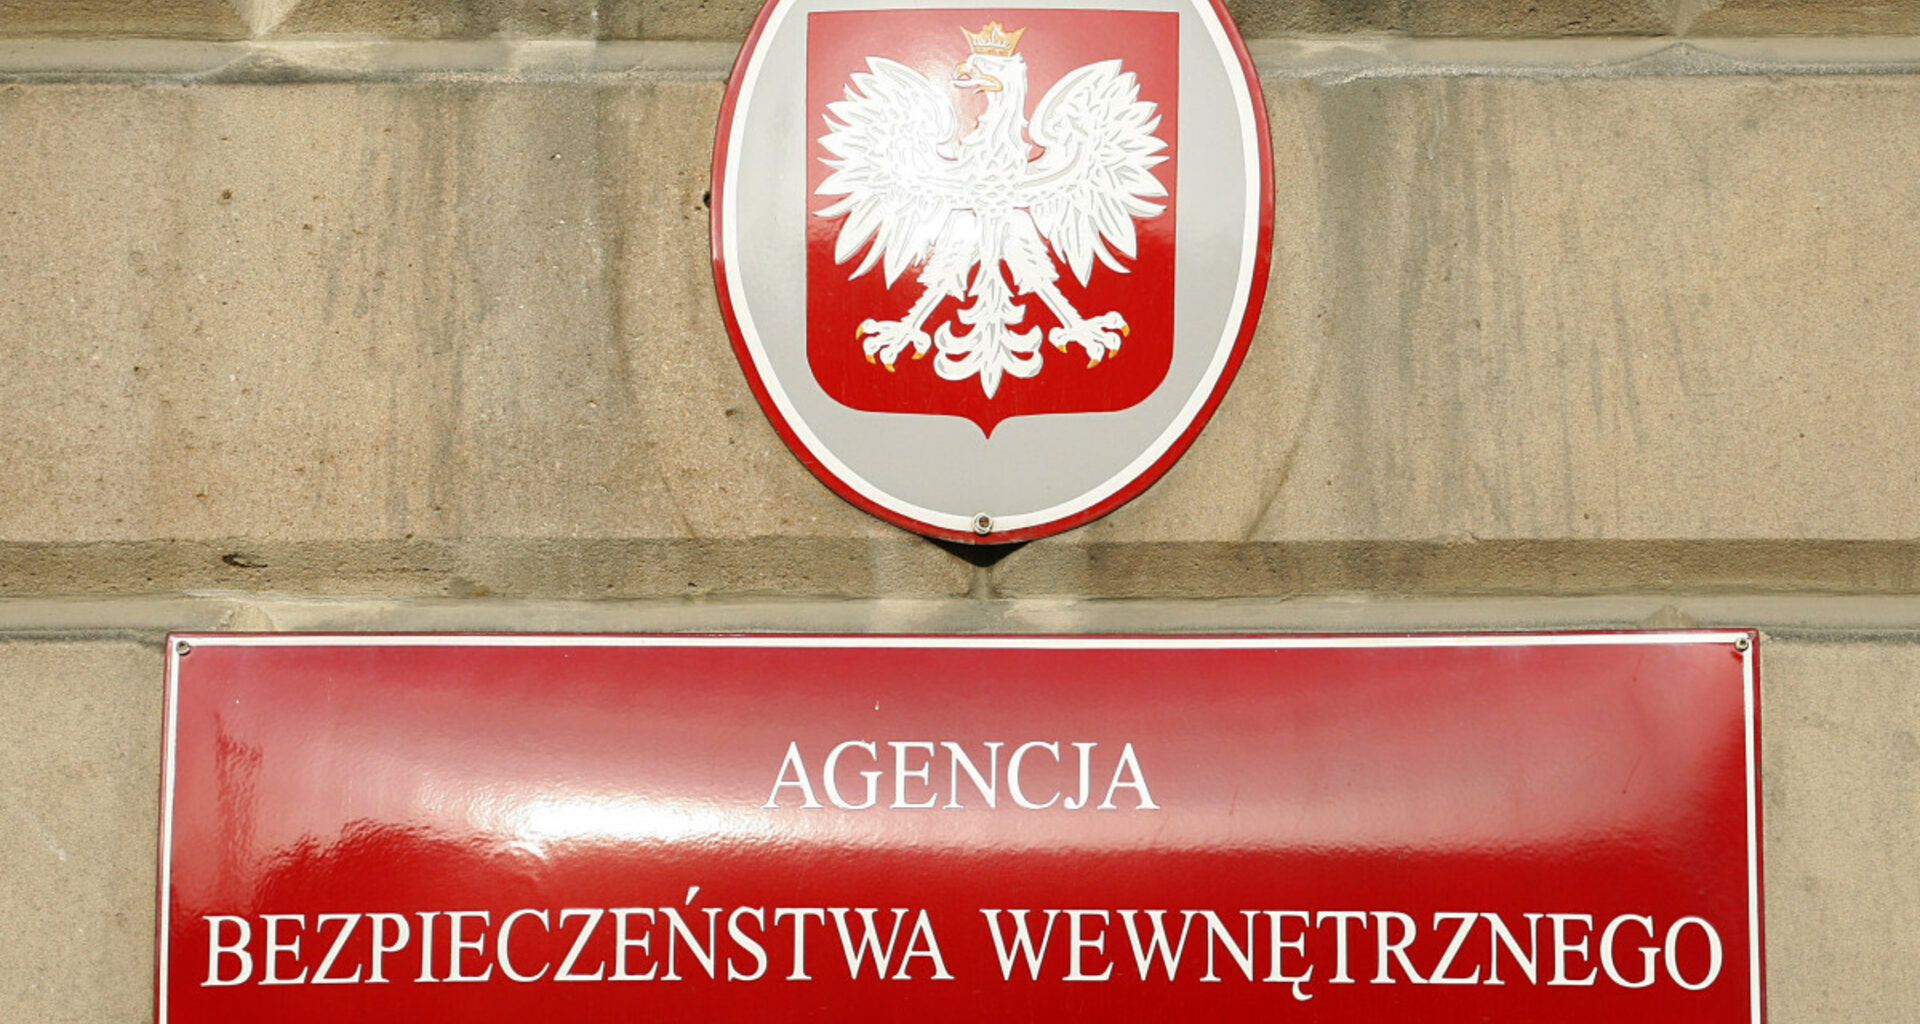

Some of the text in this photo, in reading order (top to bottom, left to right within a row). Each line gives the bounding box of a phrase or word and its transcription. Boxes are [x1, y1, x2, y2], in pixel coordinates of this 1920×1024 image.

[761, 740, 1160, 811] AGENCJA
[200, 885, 1724, 1001] BEZPIECZEŃSTWA WEWNĘTRZNEGO
